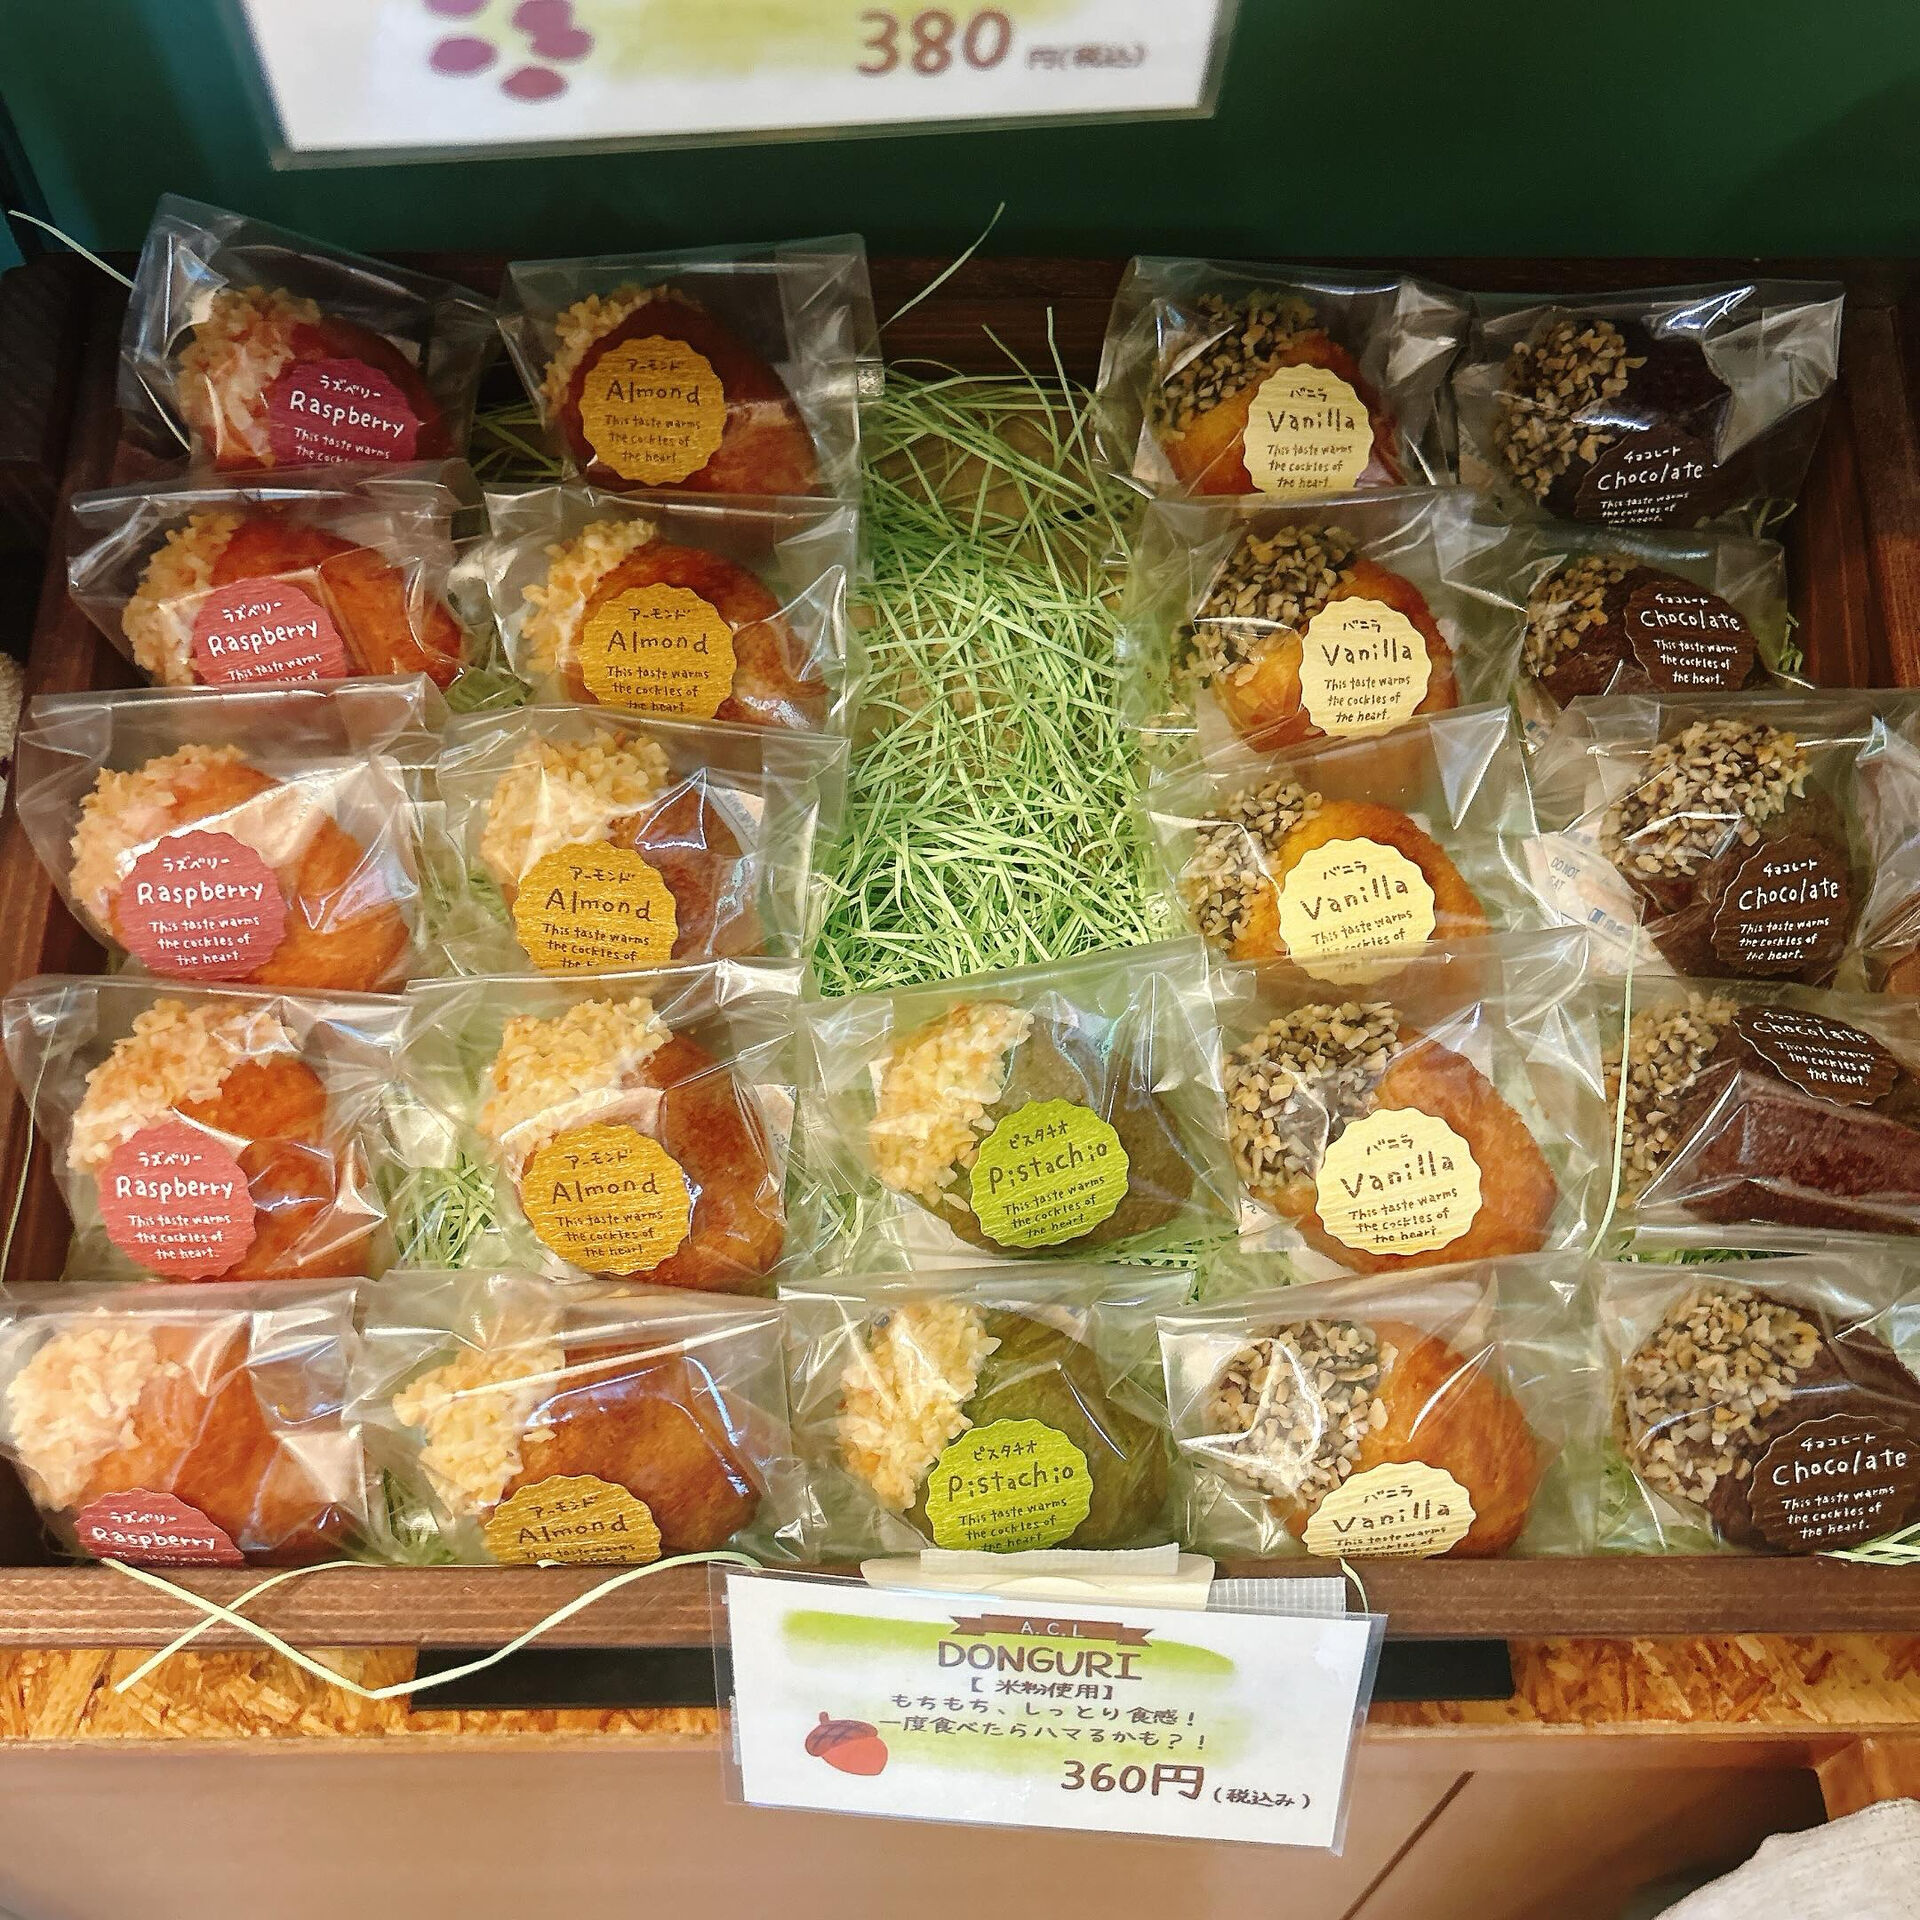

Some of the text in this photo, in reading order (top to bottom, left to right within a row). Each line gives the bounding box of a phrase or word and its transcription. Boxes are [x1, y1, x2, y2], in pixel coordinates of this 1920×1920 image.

[856, 9, 1013, 77] 380
[320, 375, 381, 399] ラズベリー
[606, 380, 700, 405] Almond
[1290, 387, 1327, 402] バニラ
[290, 390, 404, 438] Raspberry
[1267, 408, 1355, 432] Vanilla
[1598, 462, 1703, 490] Chocolate
[222, 602, 282, 623] ラズベリー
[628, 608, 690, 621] アーモンド
[1640, 609, 1740, 631] Chocolate
[1343, 620, 1381, 633] バニラ
[207, 620, 318, 658] Raspberry
[608, 630, 708, 654] Almond
[1653, 639, 1738, 654] This taste warms
[1321, 638, 1412, 667] Vanilla
[1660, 654, 1730, 670] the cockles of
[228, 653, 322, 681] This taste warms
[606, 666, 710, 680] This taste warms
[1672, 671, 1689, 683] the
[1324, 676, 1411, 691] This taste warms
[1328, 692, 1401, 707] the cockles of
[1336, 713, 1353, 723] the
[162, 856, 231, 873] ラズベリー
[570, 864, 636, 884] アーモンド
[1323, 861, 1368, 880] バニラ
[136, 881, 264, 909] Raspberry
[545, 888, 652, 922] Almond
[1300, 874, 1409, 920] Vanilla
[1739, 878, 1840, 911] Chocolate
[149, 916, 260, 934] This taste warms
[542, 922, 650, 946] This taste warms
[1312, 910, 1413, 945] This taste warms
[1740, 917, 1830, 934] This taste warms
[157, 932, 251, 950] the cockles of
[547, 940, 637, 962] the cockles of
[1739, 933, 1818, 948] the cockles of
[176, 954, 198, 966] the
[1745, 952, 1763, 961] the
[1753, 1022, 1868, 1045] Chocolate
[1788, 1053, 1808, 1064] the
[1860, 1063, 1871, 1073] of
[1806, 1067, 1827, 1081] the
[1009, 1120, 1068, 1150] ピスタチオ
[1367, 1134, 1415, 1156] バニラ
[138, 1151, 203, 1167] ラズベリー
[565, 1150, 633, 1170] アーモンド
[989, 1142, 1107, 1195] Pistachio
[1340, 1151, 1455, 1199] Vanilla
[116, 1175, 233, 1205] Raspberry
[552, 1173, 659, 1204] Almond
[1002, 1176, 1105, 1216] This taste warms
[1011, 1194, 1096, 1229] the cockles of
[1348, 1188, 1458, 1221] This taste warms
[128, 1214, 232, 1228] This taste warms
[555, 1211, 664, 1228] This taste warms
[1356, 1207, 1450, 1232] the cockles of
[135, 1230, 223, 1243] the cockles of
[565, 1231, 586, 1242] the
[642, 1228, 655, 1239] of
[1027, 1227, 1046, 1238] the
[1373, 1233, 1395, 1243] the
[154, 1249, 176, 1260] the
[973, 1440, 1037, 1461] ピスタチオ
[1800, 1433, 1876, 1451] チョコレート
[1772, 1449, 1907, 1486] Chocolate
[948, 1462, 1074, 1502] Pistachio
[1364, 1485, 1413, 1504] バニラ
[1781, 1486, 1895, 1511] This taste warms
[958, 1499, 1067, 1526] This taste warms
[1332, 1499, 1450, 1533] Vanilla
[1788, 1502, 1882, 1524] the cockles of
[92, 1527, 215, 1550] Raspberry
[519, 1514, 628, 1544] Almond
[965, 1515, 1056, 1541] the cockles of
[1800, 1527, 1822, 1539] the
[938, 1640, 1142, 1680] DONGURI
[1061, 1760, 1205, 1800] 360円
